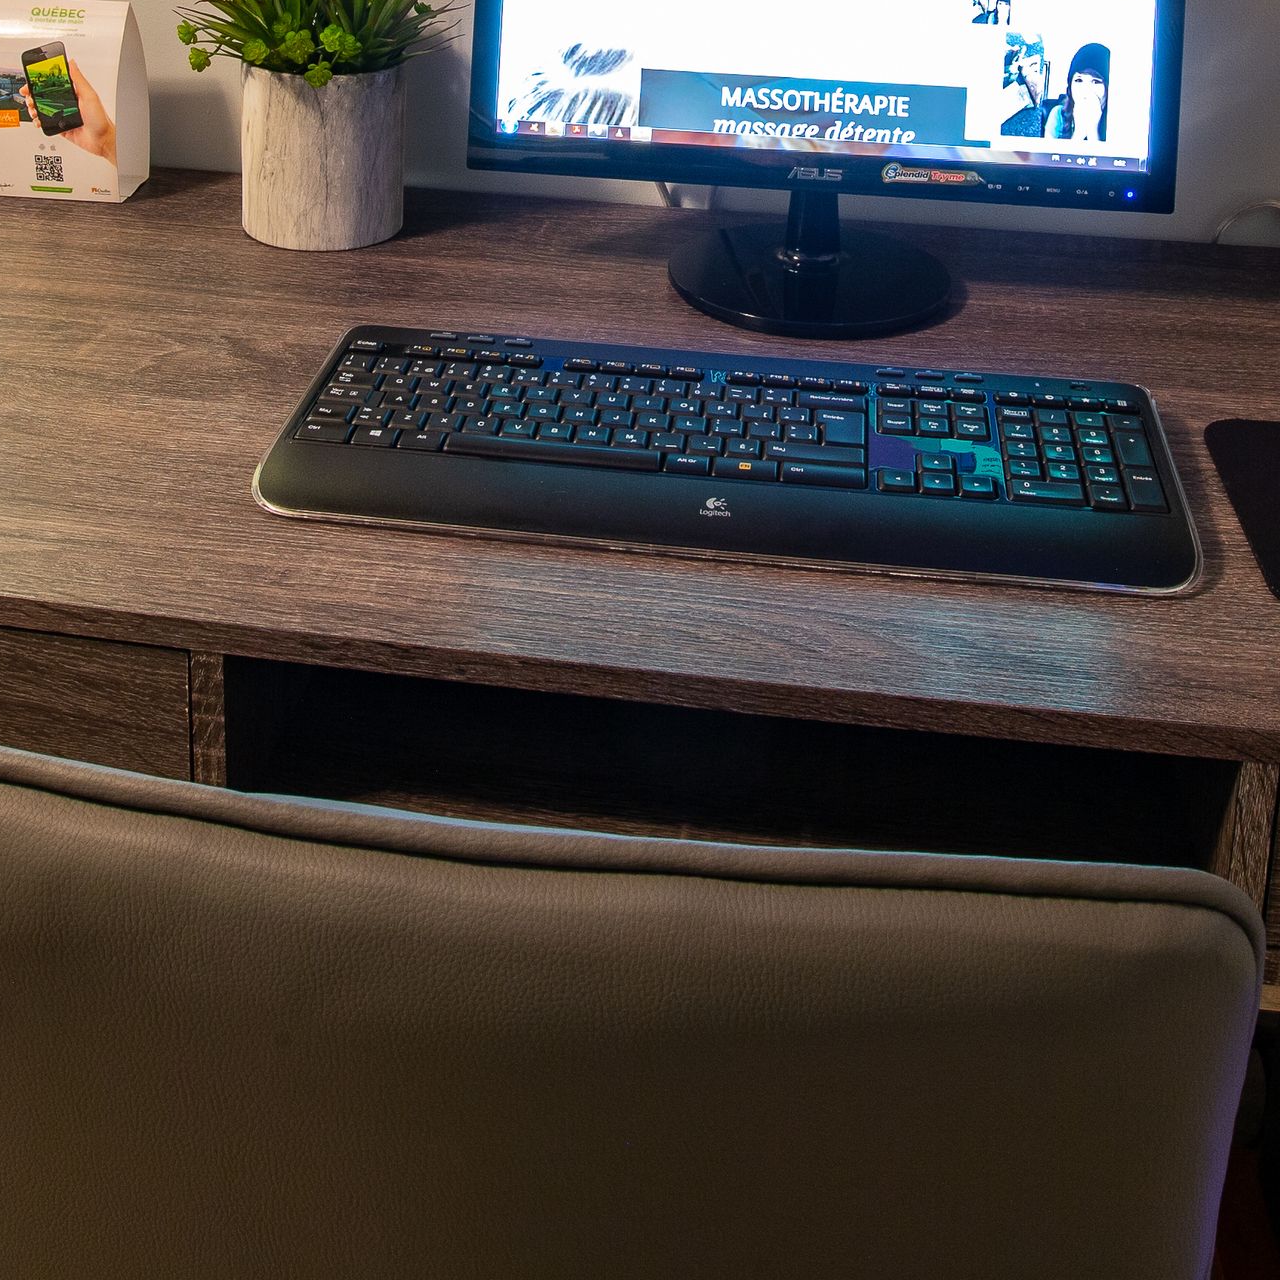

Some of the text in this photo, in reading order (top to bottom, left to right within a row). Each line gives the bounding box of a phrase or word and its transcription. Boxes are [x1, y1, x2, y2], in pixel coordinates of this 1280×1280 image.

[32, 6, 85, 18] QUÉBEC
[721, 87, 910, 117] MASSOTHÉRAPIE
[713, 118, 915, 144] massage détente
[787, 166, 843, 182] ASUS
[886, 163, 930, 180] Splendid
[700, 509, 730, 517] Logitech
